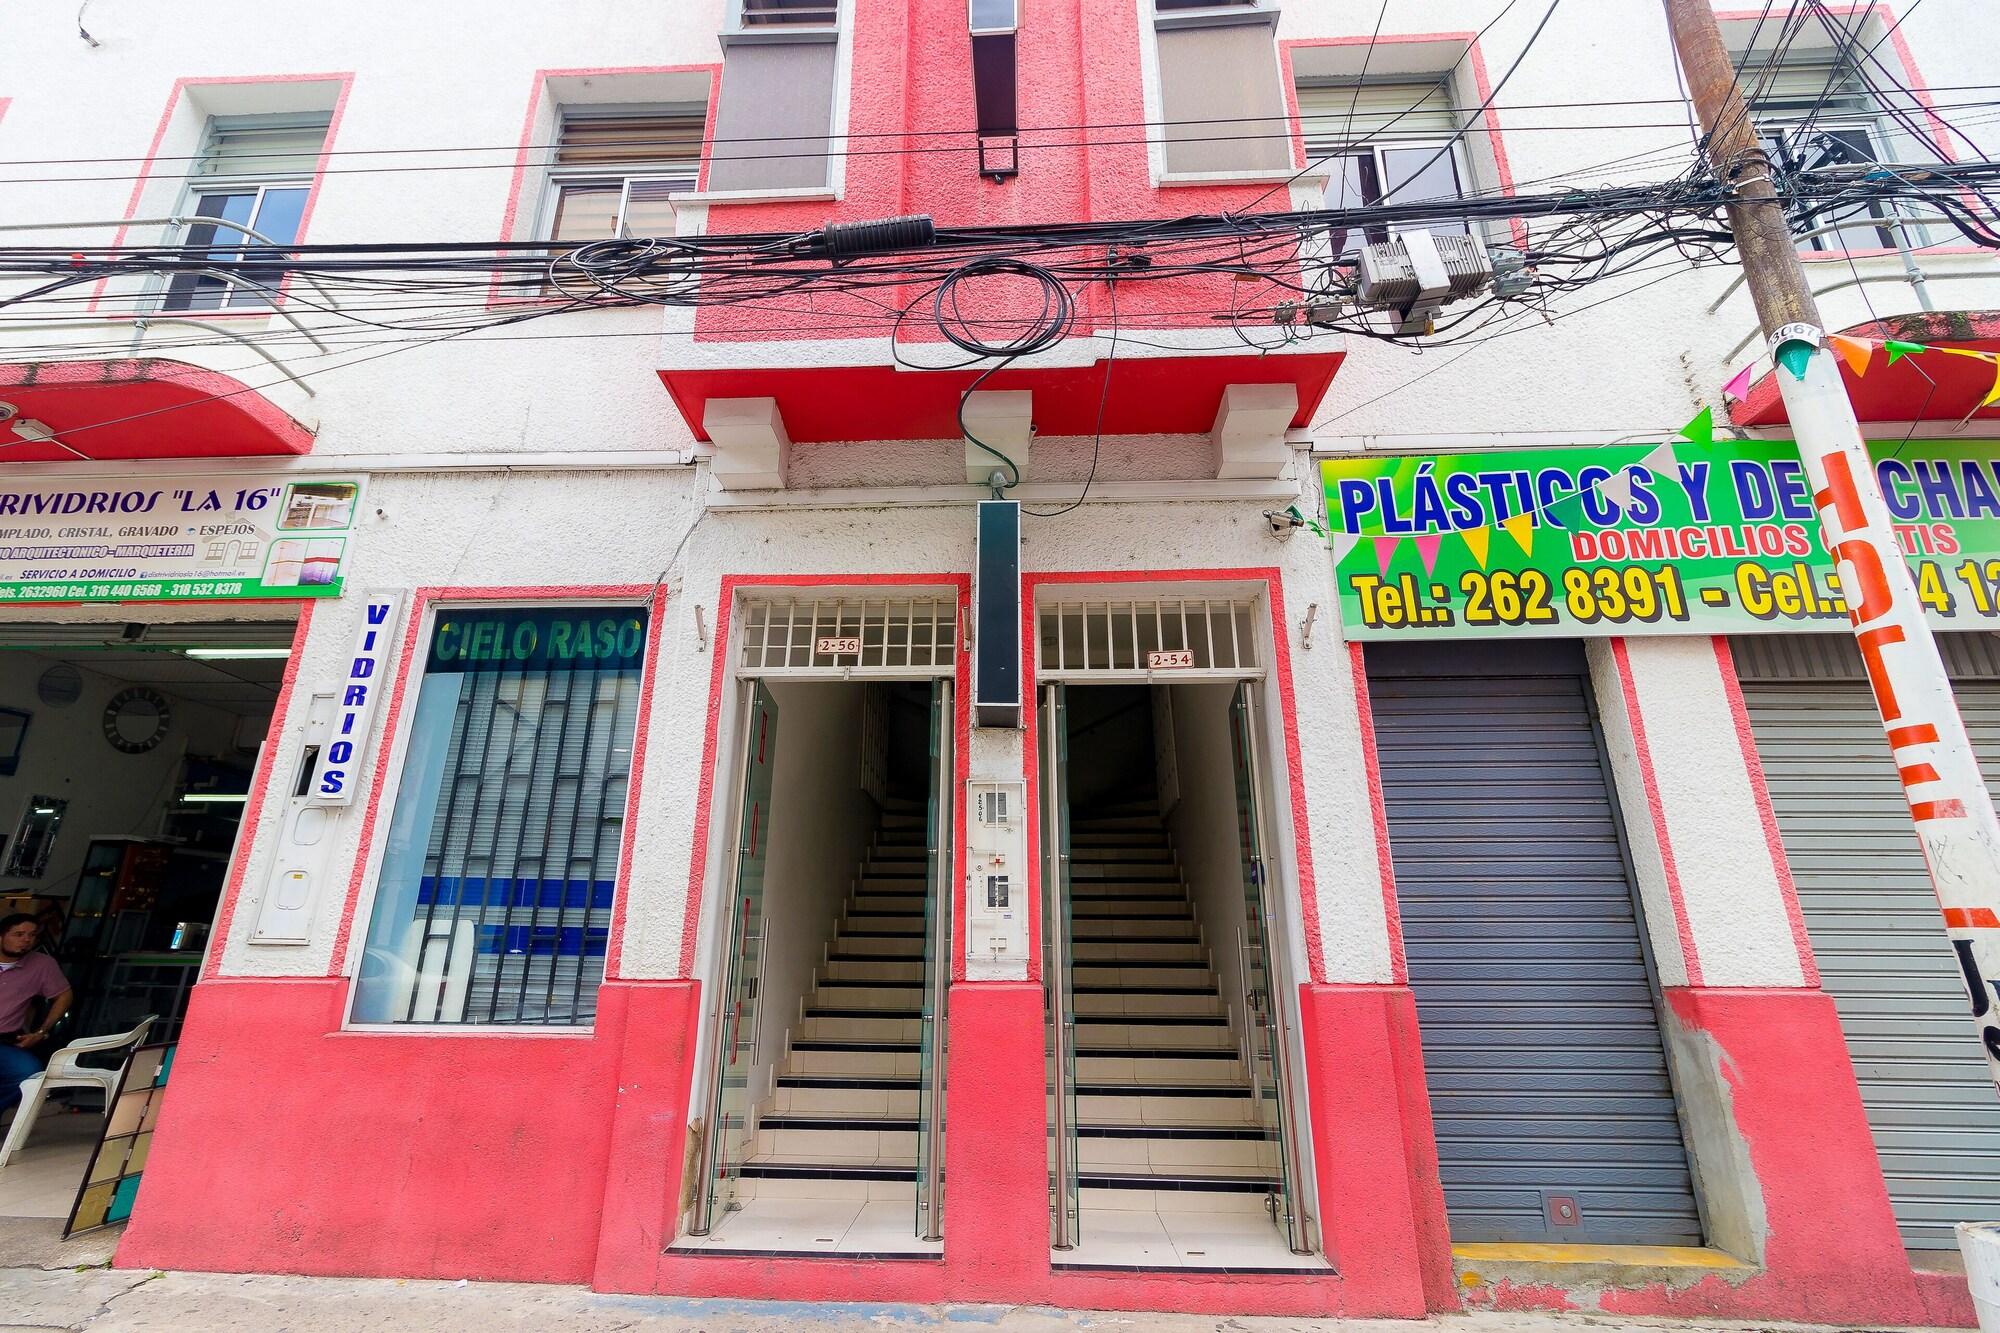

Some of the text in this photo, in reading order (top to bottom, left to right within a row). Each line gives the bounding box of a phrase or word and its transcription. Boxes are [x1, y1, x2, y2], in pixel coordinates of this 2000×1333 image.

[0, 488, 281, 514] RIVIDRIOS "LA 16"
[1338, 462, 1661, 534] PLÁSTICOS
[1677, 462, 1710, 523] Y
[58, 527, 113, 538] CRISTAL,
[118, 525, 179, 537] GRAVADO
[199, 524, 255, 536] ESPEJOS
[1570, 524, 1811, 561] DOMICILIOS
[20, 568, 136, 579] SERVICIO A DOMICILIO
[18, 585, 67, 598] 2632960
[68, 584, 88, 597] Cel.
[89, 584, 110, 597] 316
[110, 584, 132, 597] 440
[170, 583, 192, 596] 318
[192, 583, 214, 595] 532
[1349, 573, 1455, 629] Tel.:
[1459, 568, 1560, 626] 262
[1562, 564, 1690, 624] 8391
[436, 618, 642, 661] CIELO RASO
[822, 640, 855, 651] 2-56
[1154, 654, 1189, 666] 2-54
[320, 604, 390, 794] VIDRIOS
